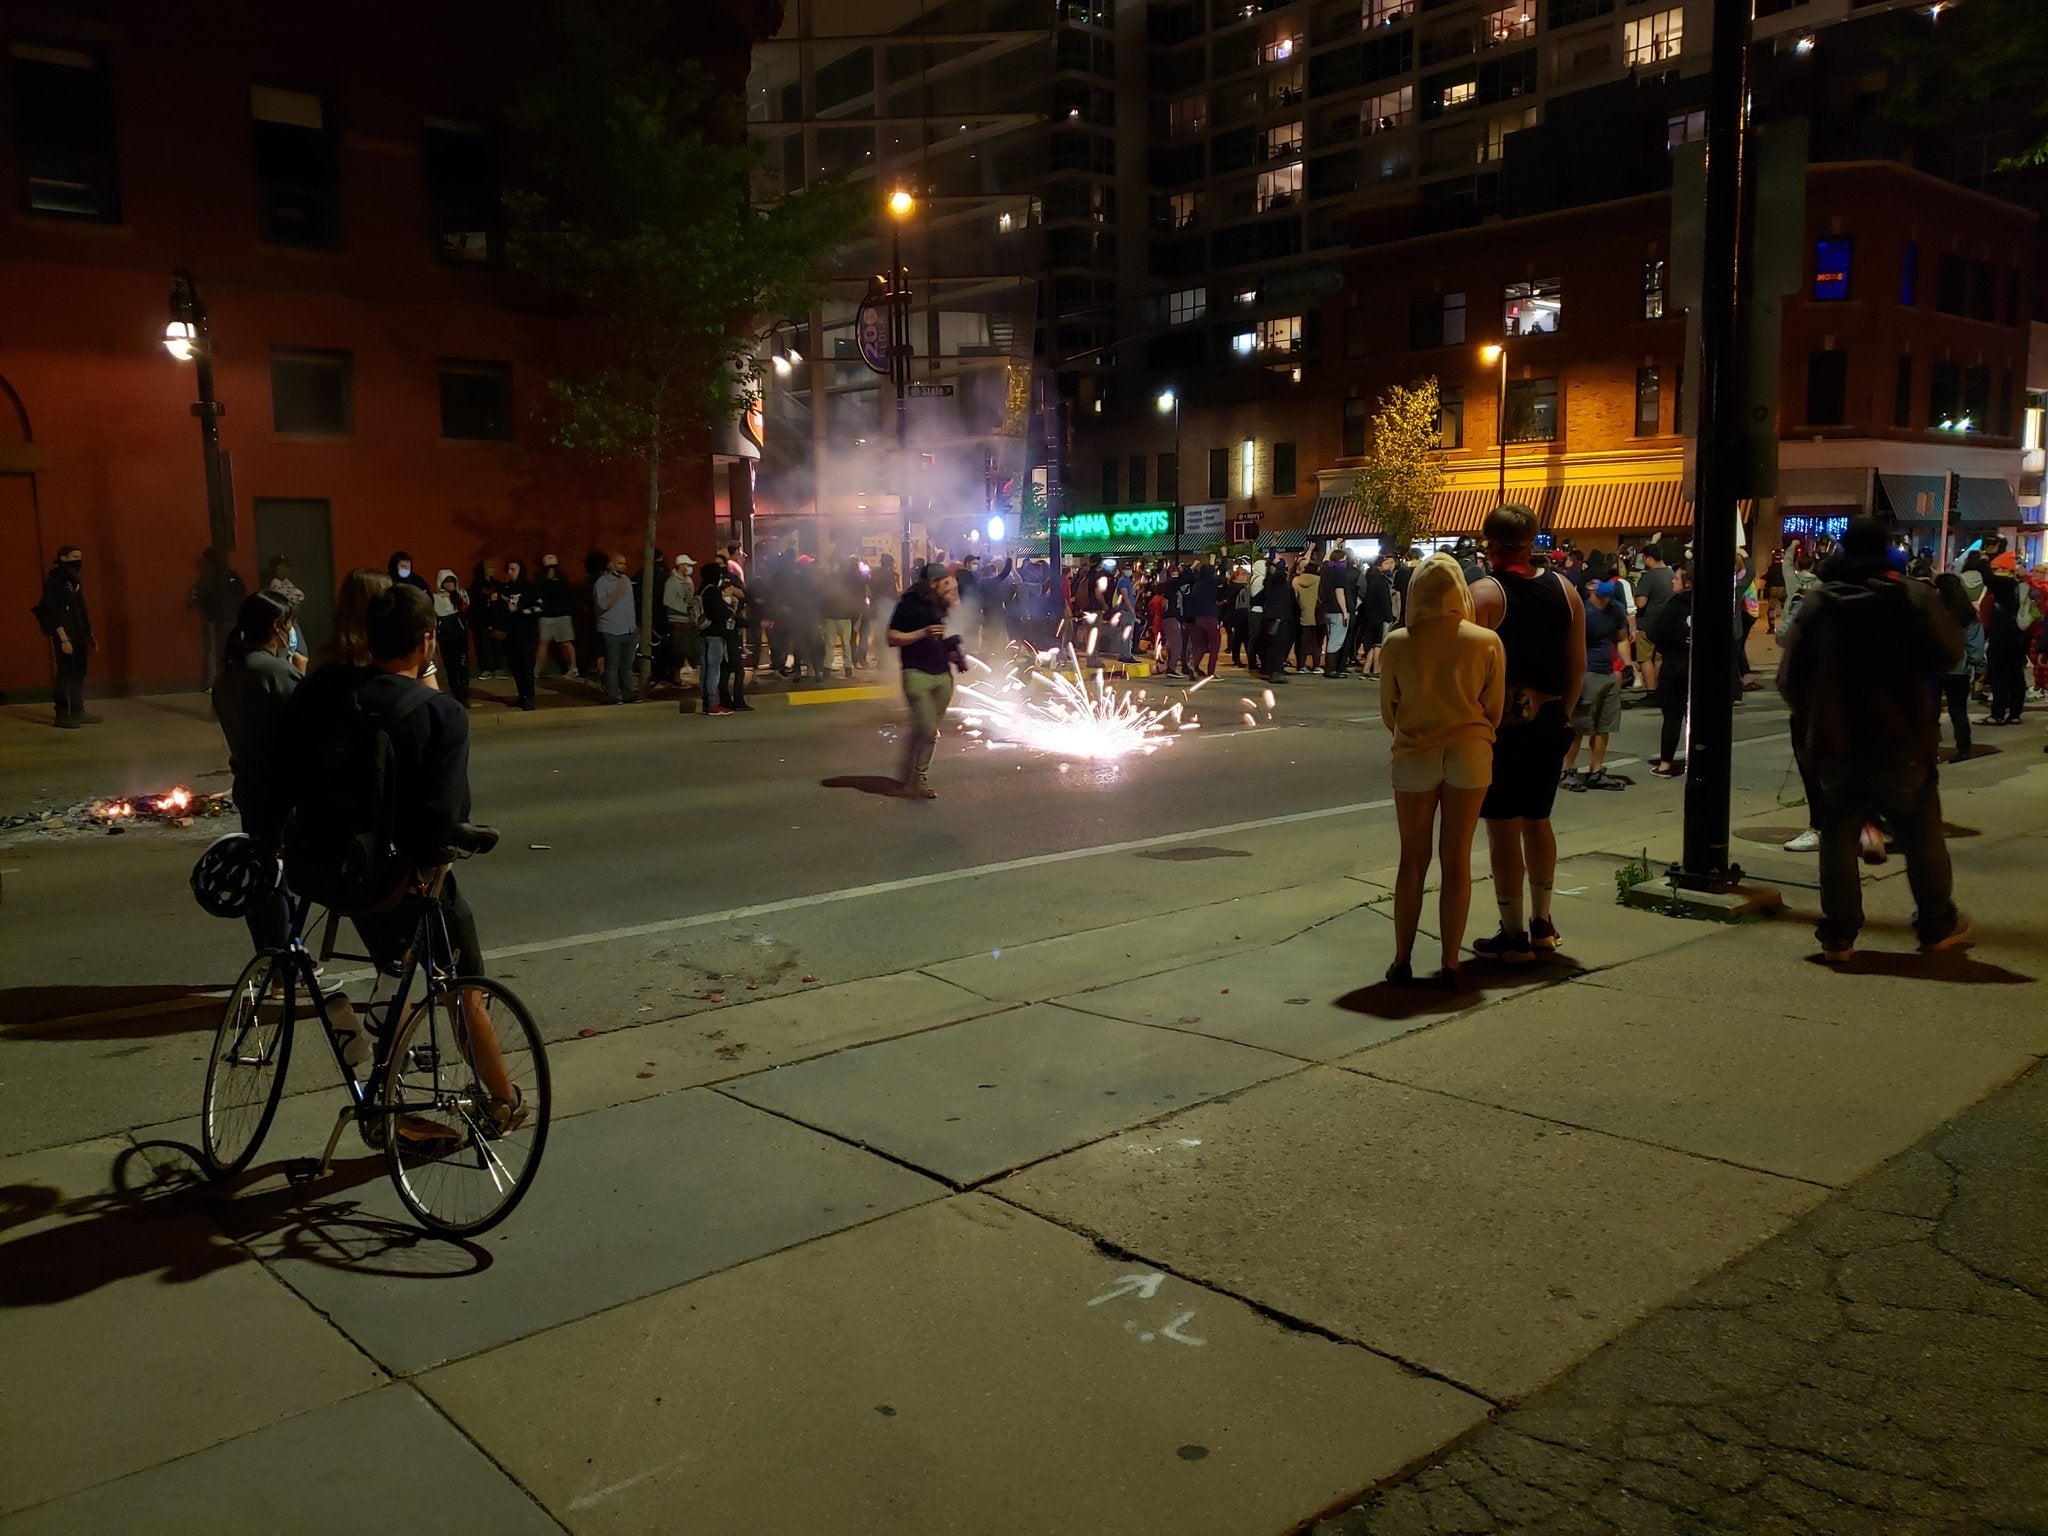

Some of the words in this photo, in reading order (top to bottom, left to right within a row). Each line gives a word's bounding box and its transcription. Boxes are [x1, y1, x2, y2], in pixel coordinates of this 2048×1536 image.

[863, 307, 879, 358] 200
[921, 386, 944, 396] State
[1112, 510, 1169, 534] SPORTS
